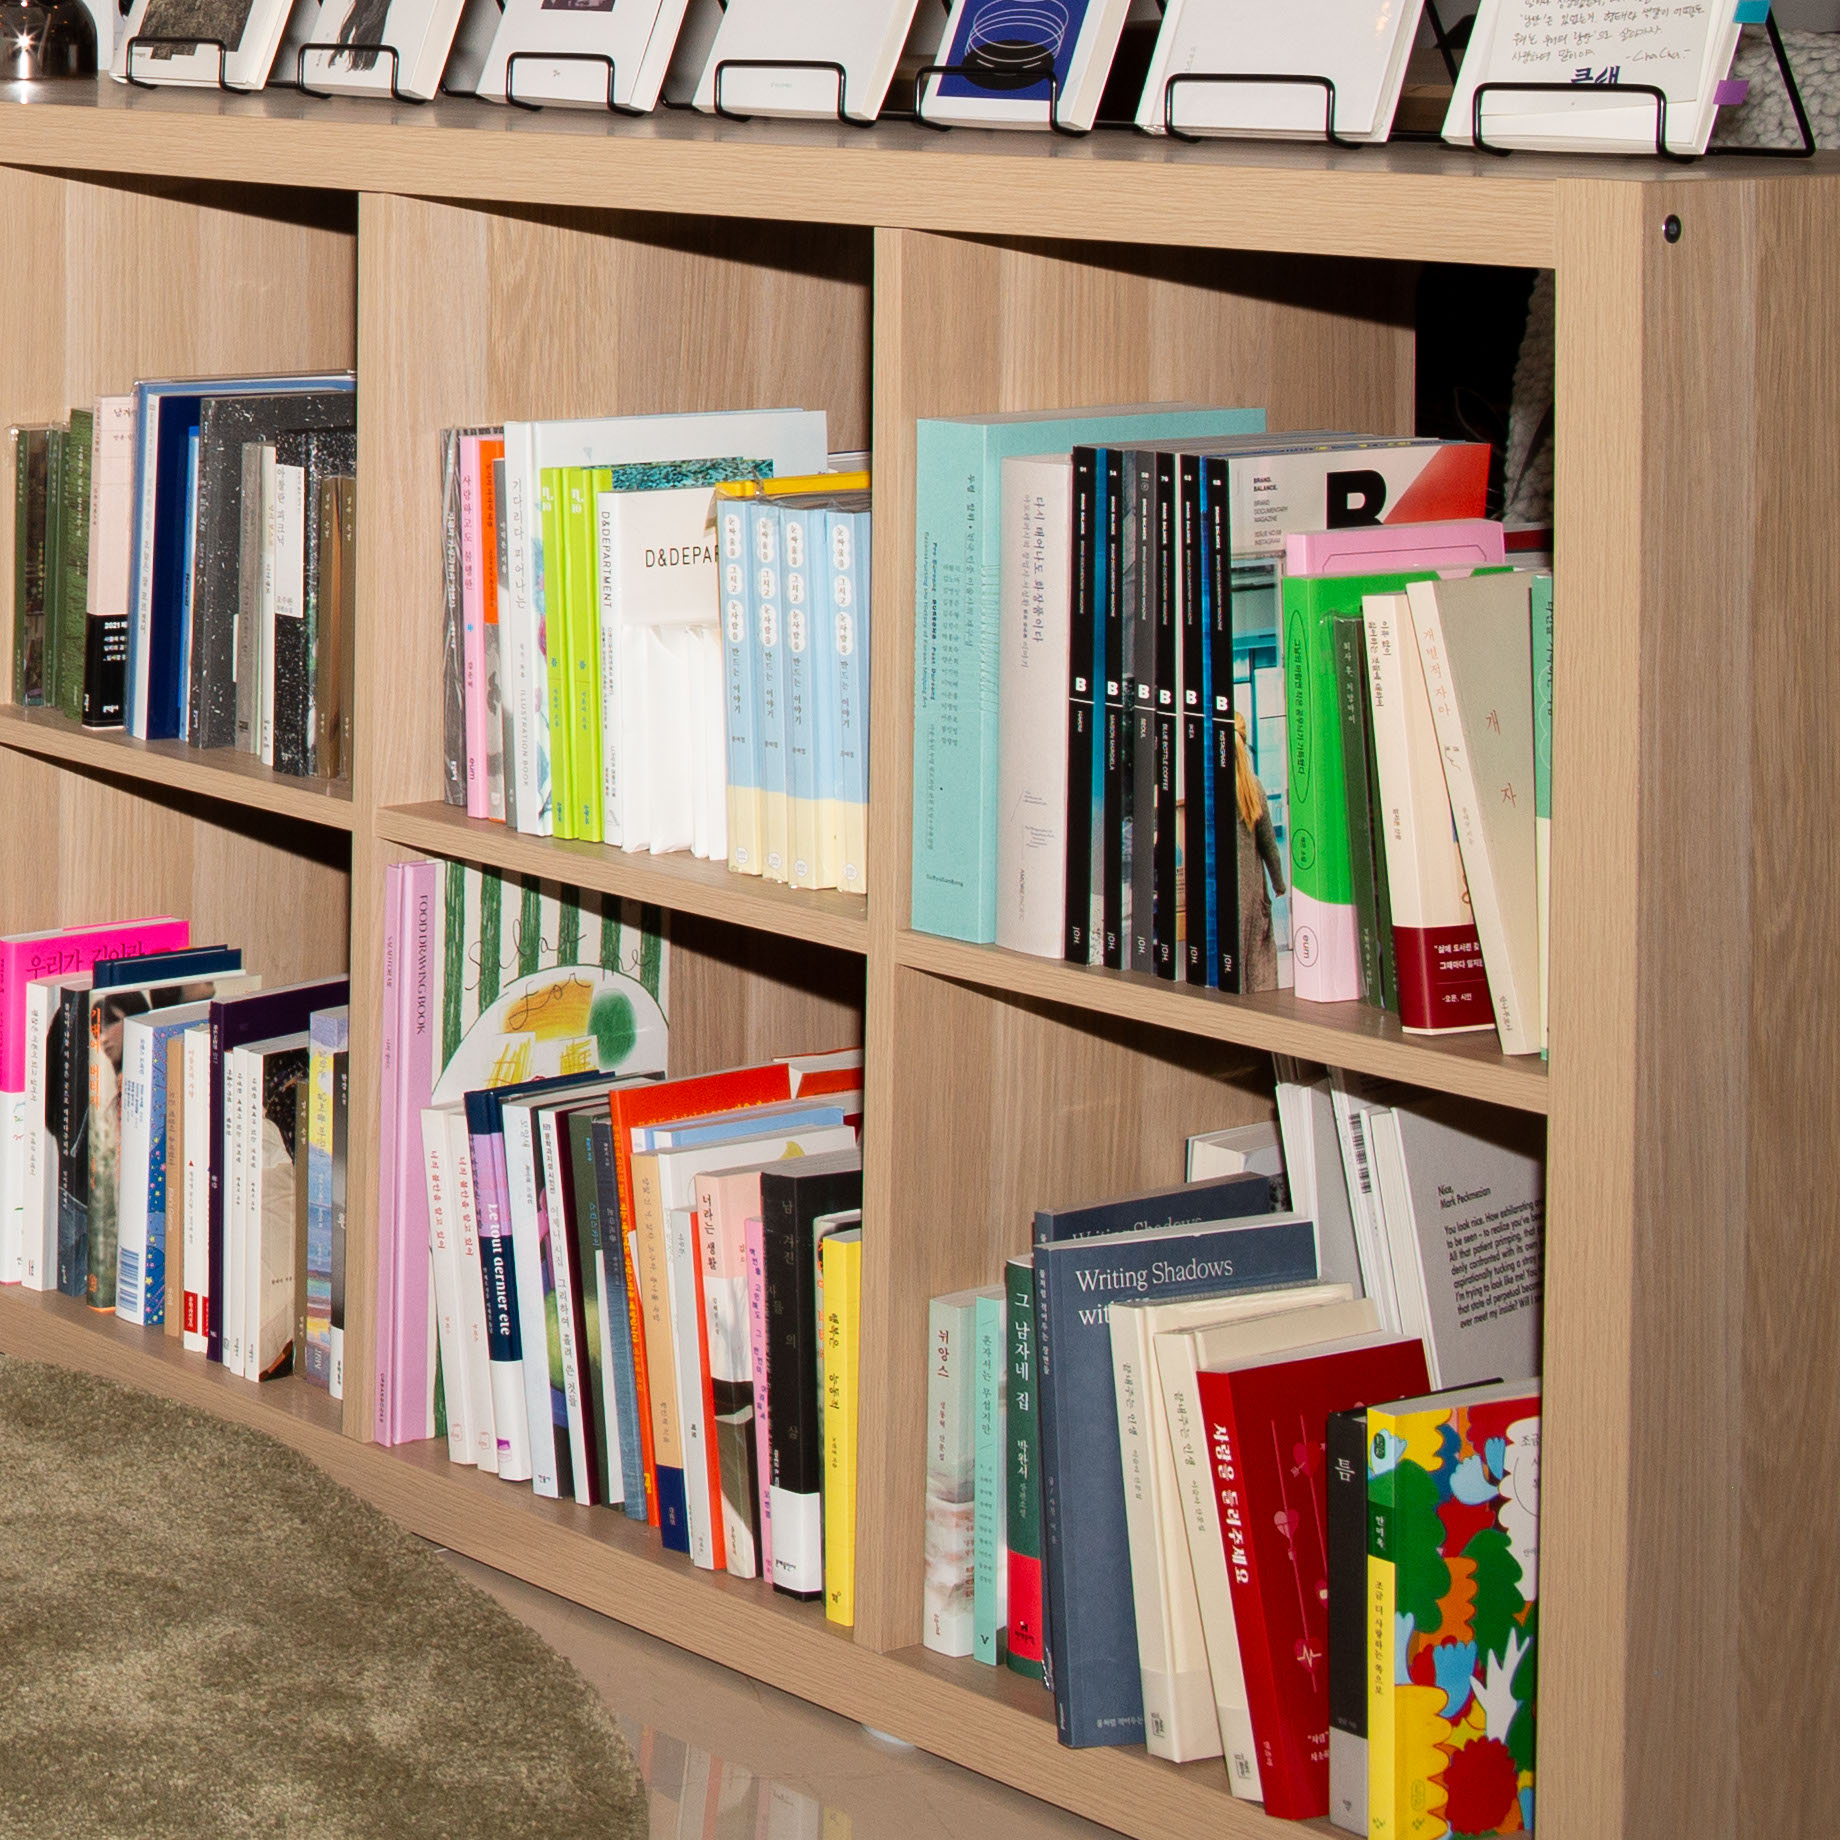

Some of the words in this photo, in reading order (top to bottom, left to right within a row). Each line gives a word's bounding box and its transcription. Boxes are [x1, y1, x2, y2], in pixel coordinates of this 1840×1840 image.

[513, 478, 523, 541] 기다리다
[1036, 496, 1046, 520] 다시
[601, 511, 612, 609] D&DEPARTMENT
[1034, 526, 1045, 575] 태어나도
[515, 547, 526, 609] 피어나는
[729, 566, 738, 593] 그치고
[1033, 579, 1045, 643] 화장품이다
[733, 685, 742, 714] 이야기
[1076, 678, 1087, 692] B
[1108, 681, 1119, 696] B
[1486, 710, 1501, 735] 개
[1501, 782, 1517, 809] 자
[25, 952, 82, 980] 우리가
[418, 927, 428, 992] DRAWING
[416, 994, 426, 1035] BOOK
[490, 1228, 502, 1259] tout
[493, 1261, 508, 1319] dernier
[1076, 1267, 1148, 1293] Writing
[1152, 1259, 1233, 1285] Shadows
[557, 1278, 570, 1328] 그리하여
[1014, 1293, 1030, 1308] 그
[937, 1329, 949, 1378] 뉘앙스
[1014, 1320, 1030, 1382] 남자네
[1015, 1391, 1029, 1411] 집
[1016, 1439, 1029, 1480] 박완서
[1213, 1423, 1235, 1481] 사랑을
[1334, 1458, 1354, 1483] 틈
[1221, 1488, 1251, 1584] 들려주세요
